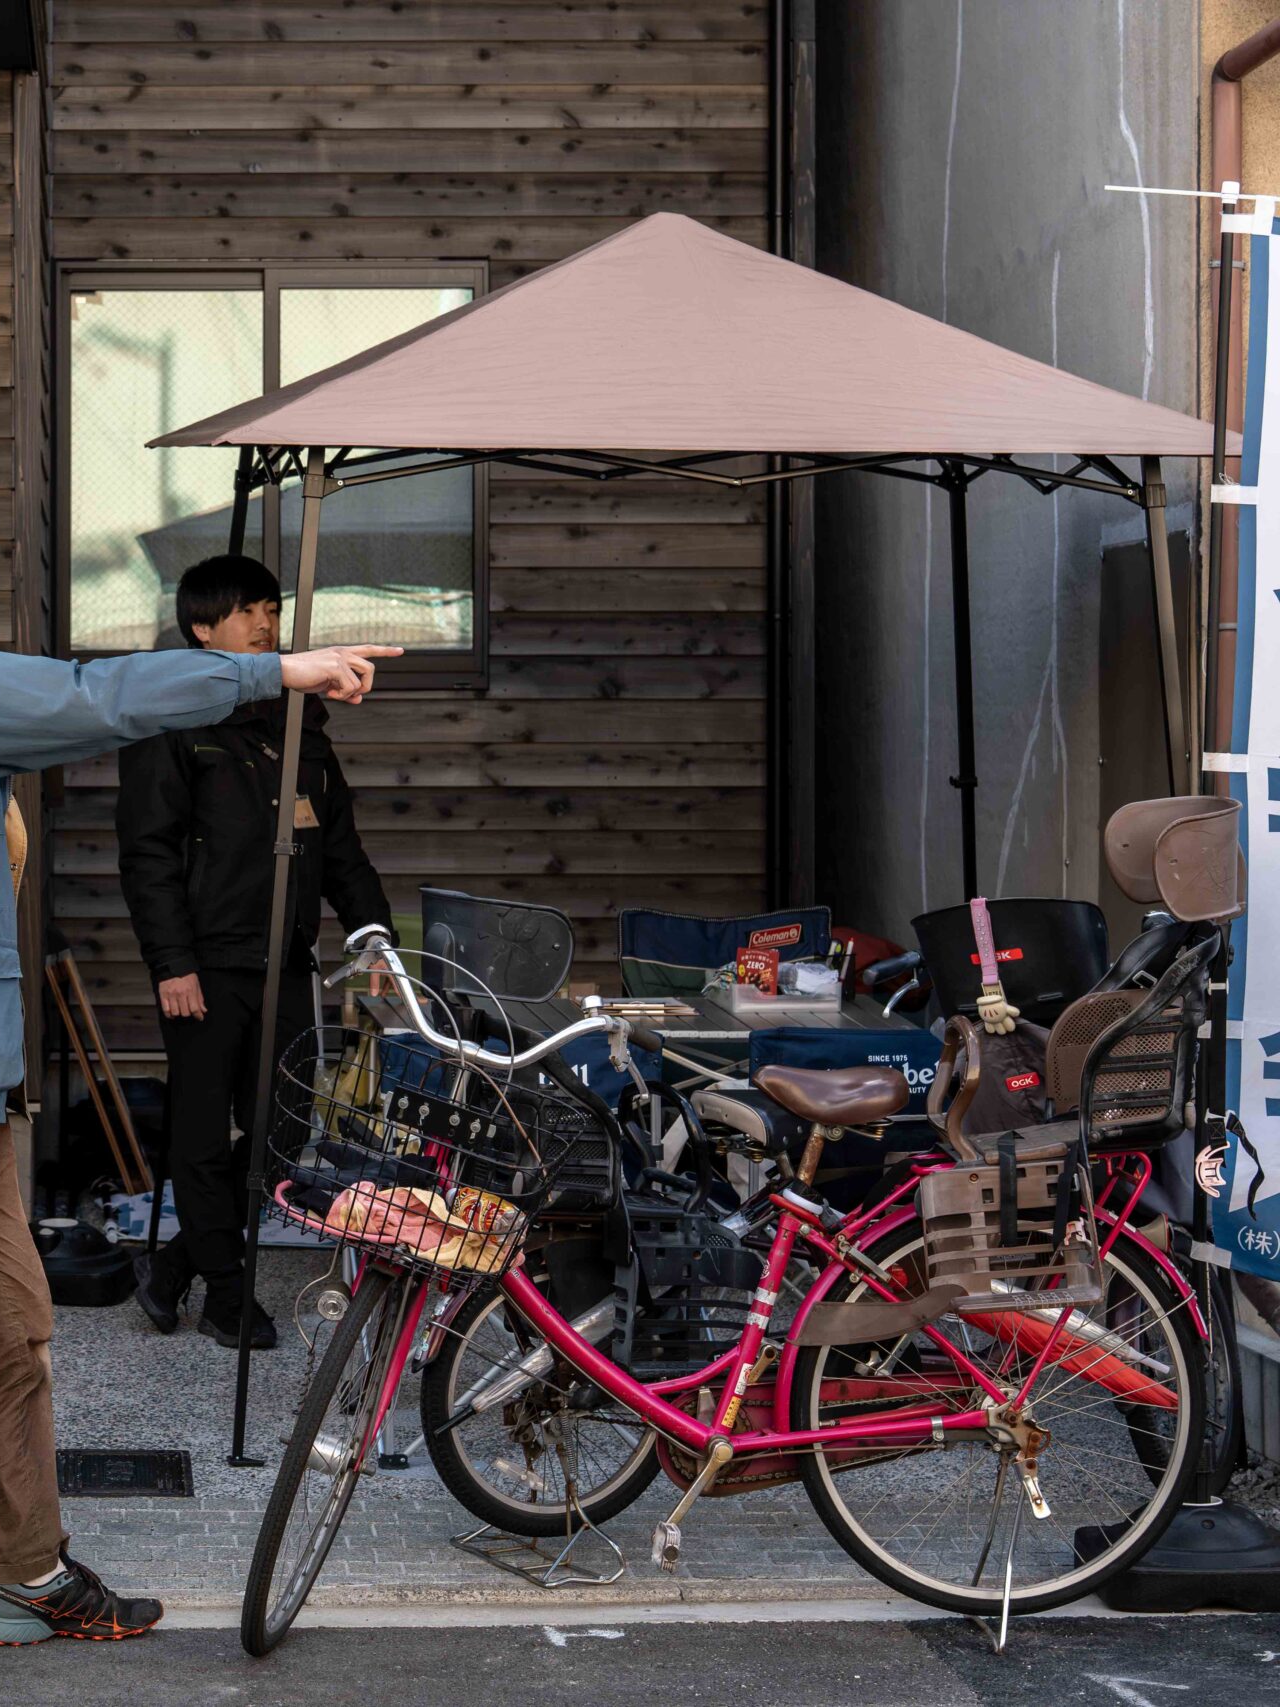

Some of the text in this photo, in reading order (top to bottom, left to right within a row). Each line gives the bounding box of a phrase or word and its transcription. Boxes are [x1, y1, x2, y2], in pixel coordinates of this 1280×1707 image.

[752, 931, 790, 945] Coleman
[995, 951, 1011, 960] GK
[746, 961, 765, 970] ZERO
[867, 1054, 908, 1063] SINCE 1975
[1011, 1075, 1033, 1087] OGK
